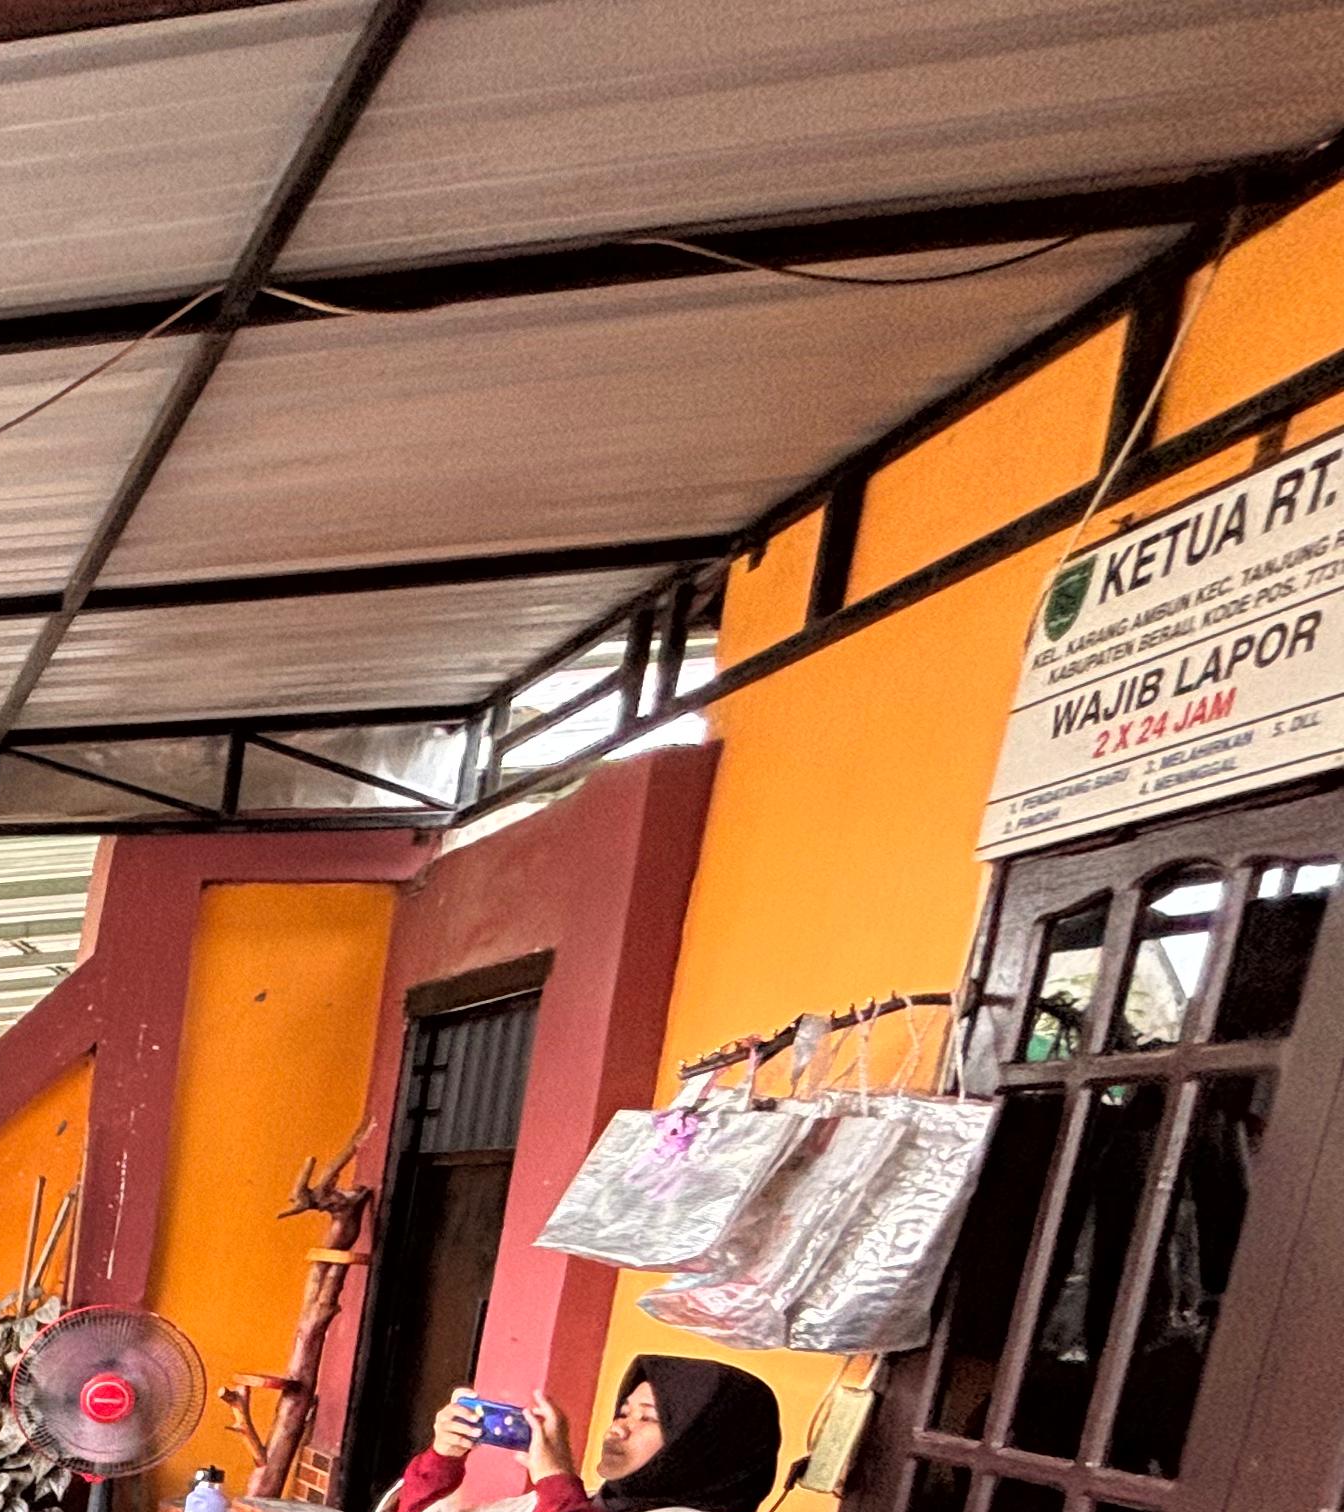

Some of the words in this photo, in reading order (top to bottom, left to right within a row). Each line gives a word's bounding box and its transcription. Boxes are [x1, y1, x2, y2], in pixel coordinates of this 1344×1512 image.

[1097, 493, 1249, 605] KETUA
[1263, 448, 1343, 534] RT.
[1032, 645, 1062, 670] KEL.
[1066, 618, 1128, 657] KARANG
[1130, 597, 1191, 637] AMBUN
[1194, 580, 1236, 613] KEC.
[1241, 535, 1330, 587] TANJUNG
[1046, 638, 1136, 686] KABUPATEN
[1202, 599, 1253, 637] KODE
[1050, 667, 1164, 739] WAJIB
[1171, 610, 1323, 697] LAPOR
[1090, 730, 1110, 759] 2
[1111, 720, 1134, 753] X
[1135, 711, 1169, 746] 24
[1173, 687, 1237, 732] JAM
